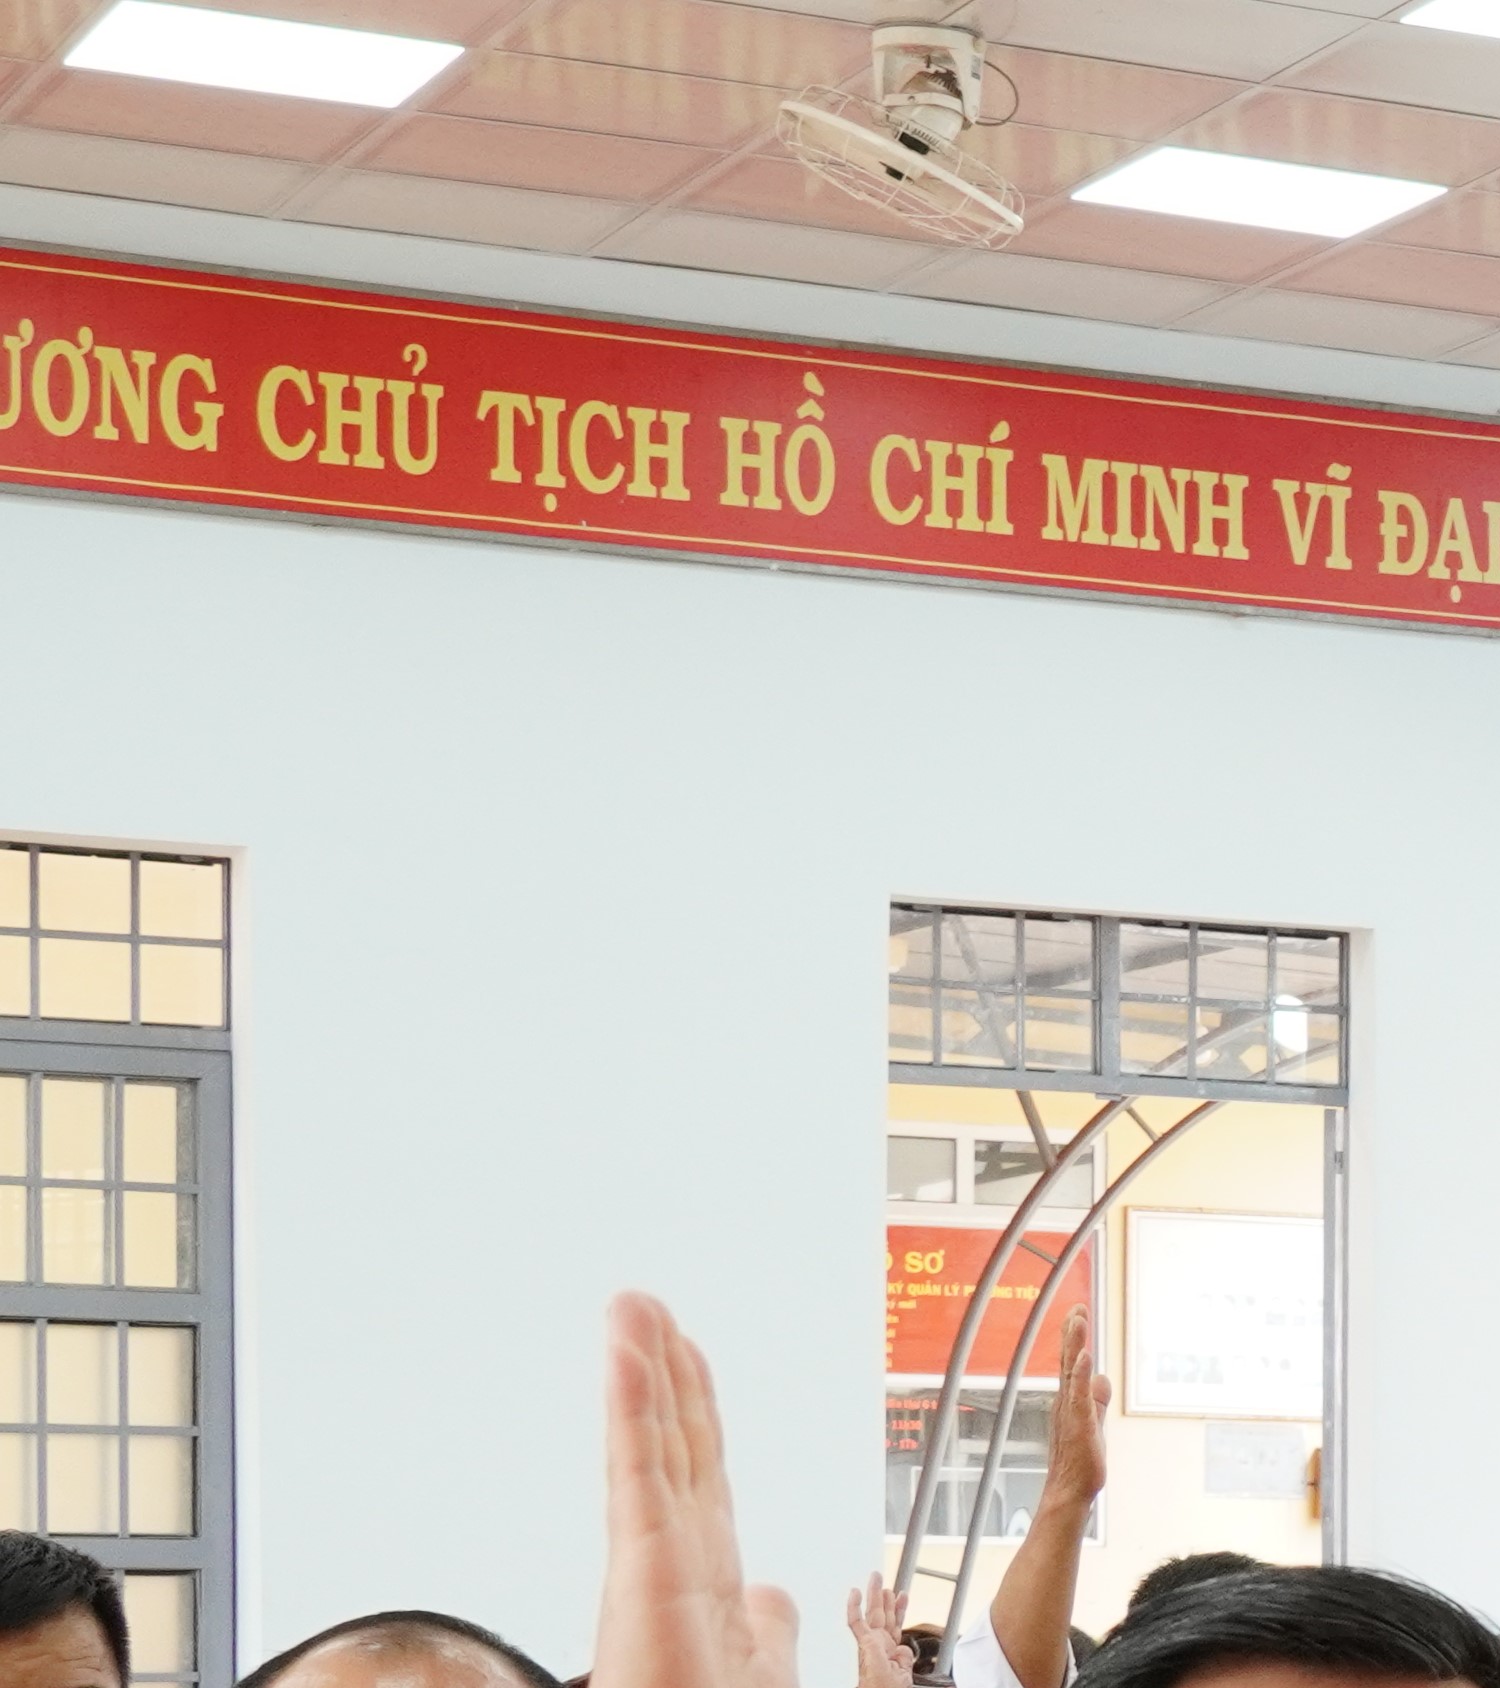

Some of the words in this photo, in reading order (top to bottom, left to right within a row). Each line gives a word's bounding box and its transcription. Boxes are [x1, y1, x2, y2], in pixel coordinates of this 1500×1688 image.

[257, 343, 444, 475] CHỦ
[476, 390, 690, 513] TỊCH
[719, 371, 836, 516] HỒ
[869, 420, 1014, 535] CHÍ
[1041, 453, 1250, 561] MINH
[1272, 463, 1353, 571] VĨ
[904, 1249, 945, 1275] SƠ
